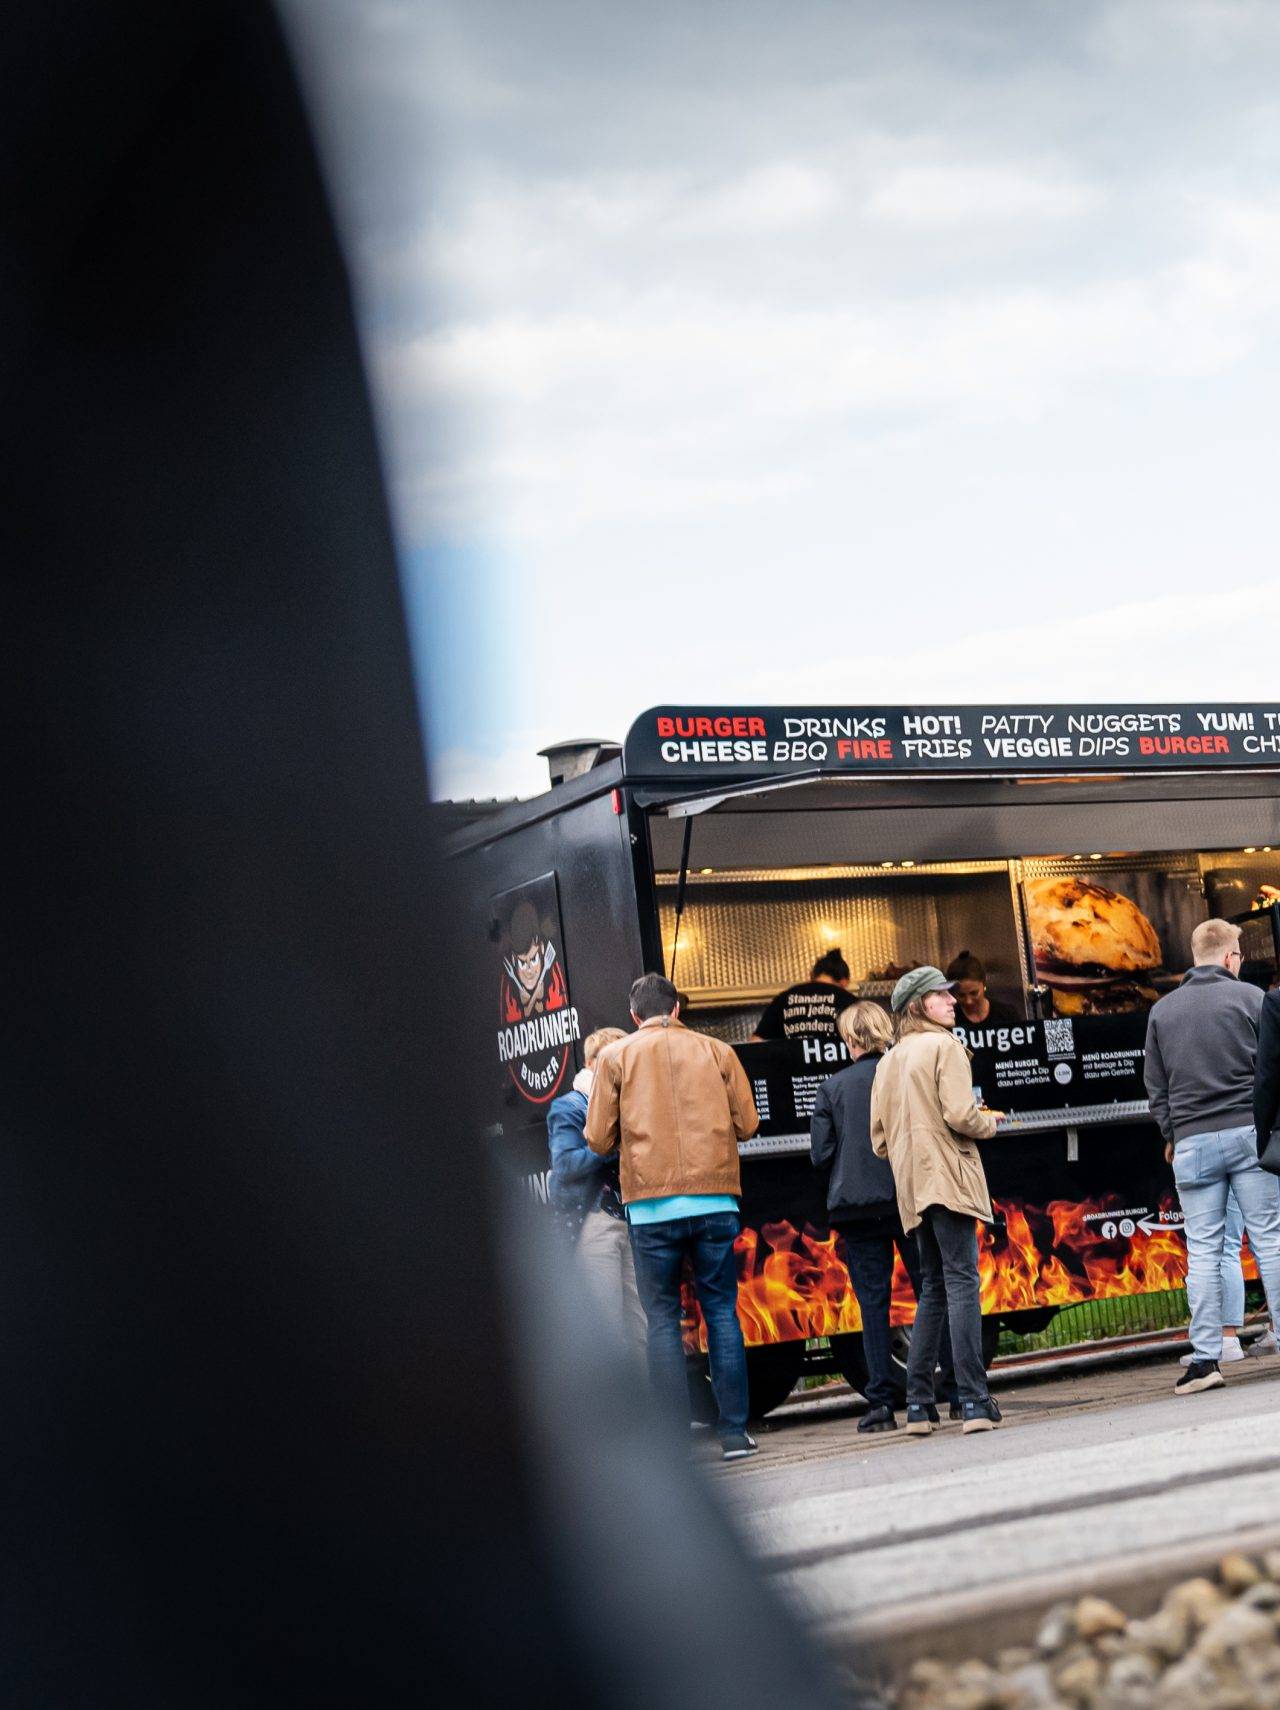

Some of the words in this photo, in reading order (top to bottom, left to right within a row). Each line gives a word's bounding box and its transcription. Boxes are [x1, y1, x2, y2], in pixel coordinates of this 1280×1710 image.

[657, 716, 766, 737] BURGER
[784, 717, 886, 739] DRINKS
[903, 715, 961, 736] HOT!
[981, 714, 1054, 734] PATTY
[1068, 713, 1180, 733] NUGGETS
[1198, 712, 1254, 731] YUM!
[661, 740, 768, 763] CHEESE
[773, 741, 827, 761] BBQ
[837, 739, 893, 759] FIRE
[902, 738, 972, 759] FRIES
[984, 737, 1073, 758] VEGGIE
[1078, 736, 1129, 757] DIPS
[1139, 735, 1229, 755] BURGER
[788, 993, 835, 1005] Standard
[497, 1006, 581, 1062] ROADRUNNER
[784, 1019, 835, 1036] besonders
[953, 1025, 1036, 1052] Burger
[520, 1056, 560, 1091] BURGER
[1015, 1058, 1039, 1068] BURGER
